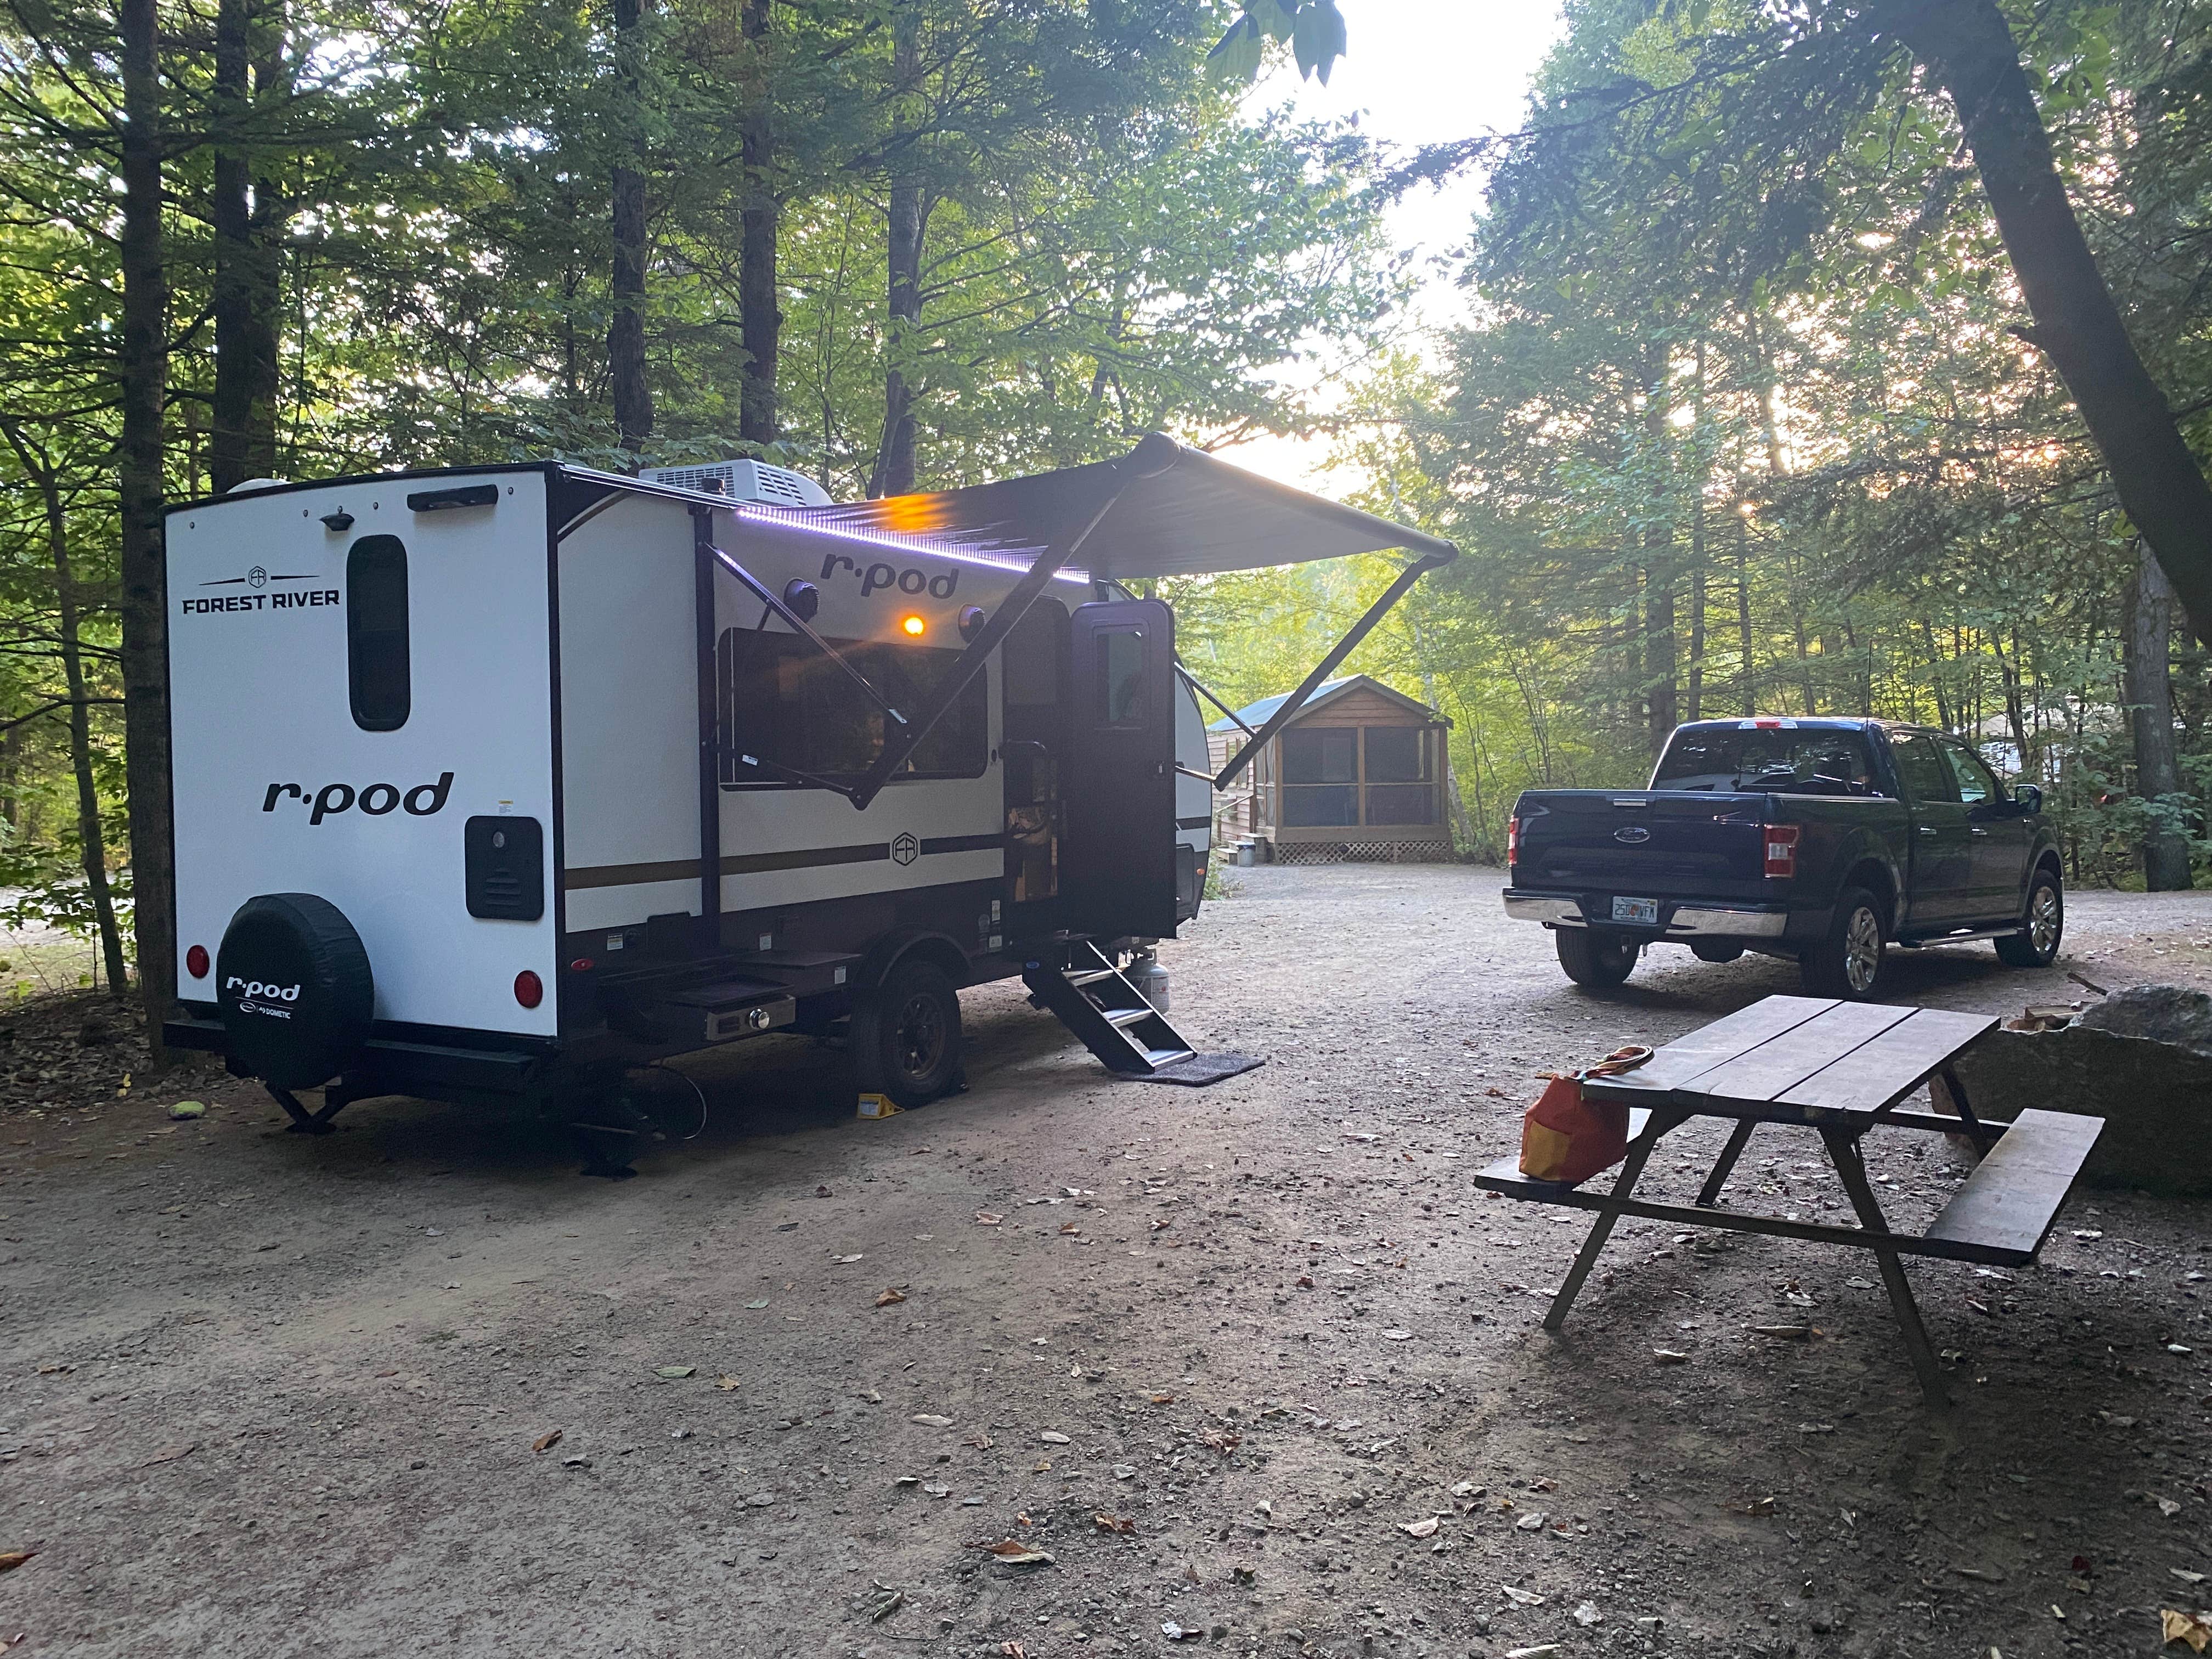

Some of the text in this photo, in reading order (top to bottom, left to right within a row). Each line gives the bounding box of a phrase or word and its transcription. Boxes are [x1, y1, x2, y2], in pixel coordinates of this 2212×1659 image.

[182, 590, 340, 614] FOREST RIVER
[266, 1008, 291, 1019] DOMETIC
